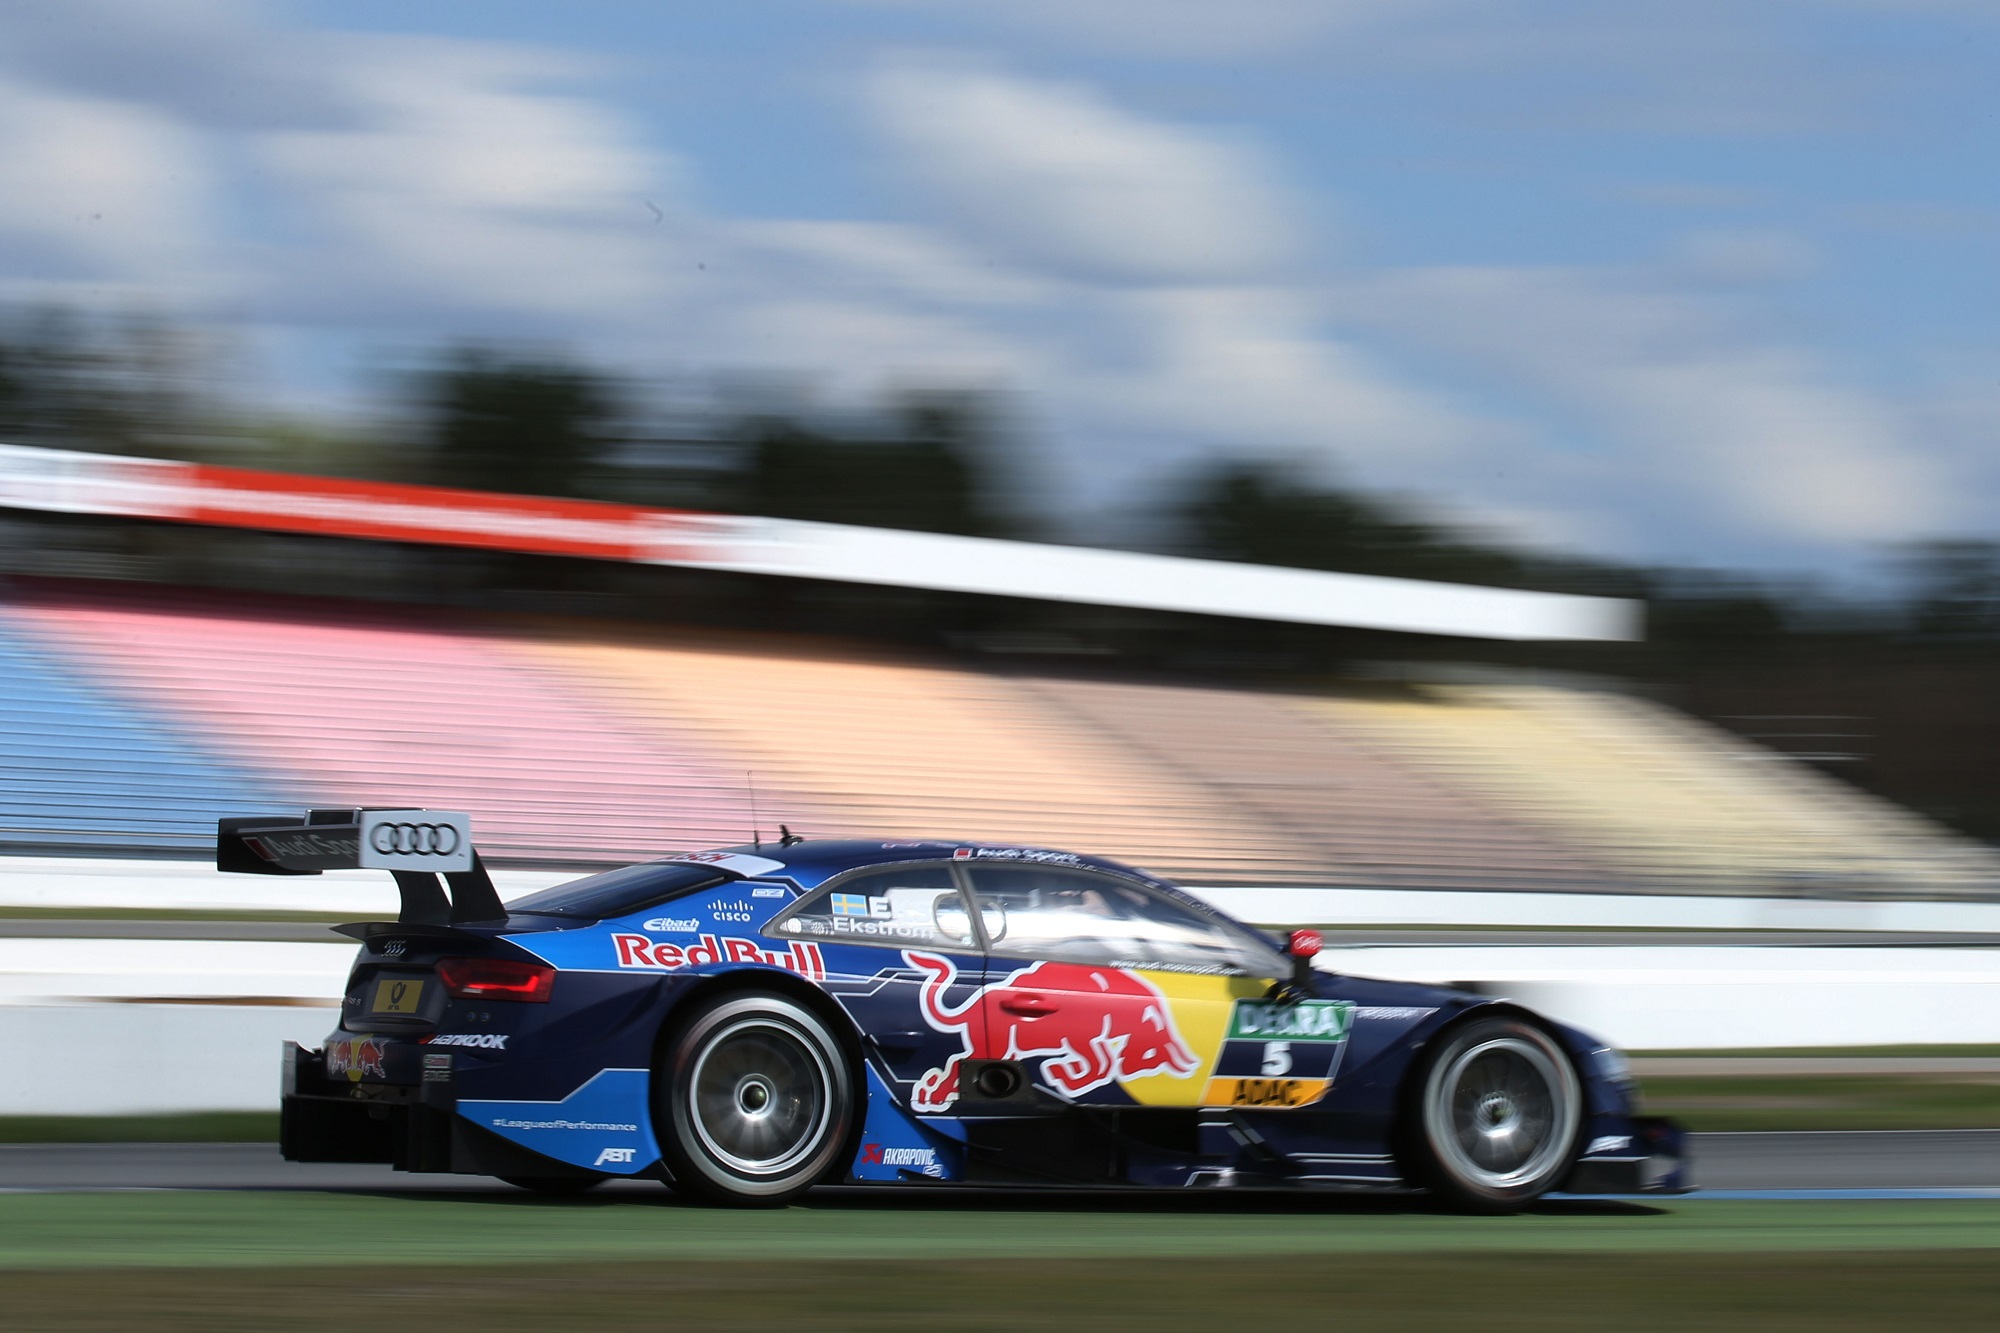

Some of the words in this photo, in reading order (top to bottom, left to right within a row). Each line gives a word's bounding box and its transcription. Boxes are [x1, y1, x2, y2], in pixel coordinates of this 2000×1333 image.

[263, 835, 325, 856] Audi
[977, 848, 1022, 859] Audi
[1022, 849, 1081, 864] Sport
[643, 917, 700, 932] Eibach
[713, 911, 751, 922] cisco
[611, 933, 722, 968] Red
[720, 937, 826, 981] Bull
[1237, 1003, 1344, 1037] DEKRA
[1260, 1041, 1293, 1076] 5
[1231, 1079, 1303, 1106] ADAC
[492, 1118, 638, 1132] #LeagueofPerformance
[593, 1147, 637, 1165] ABT
